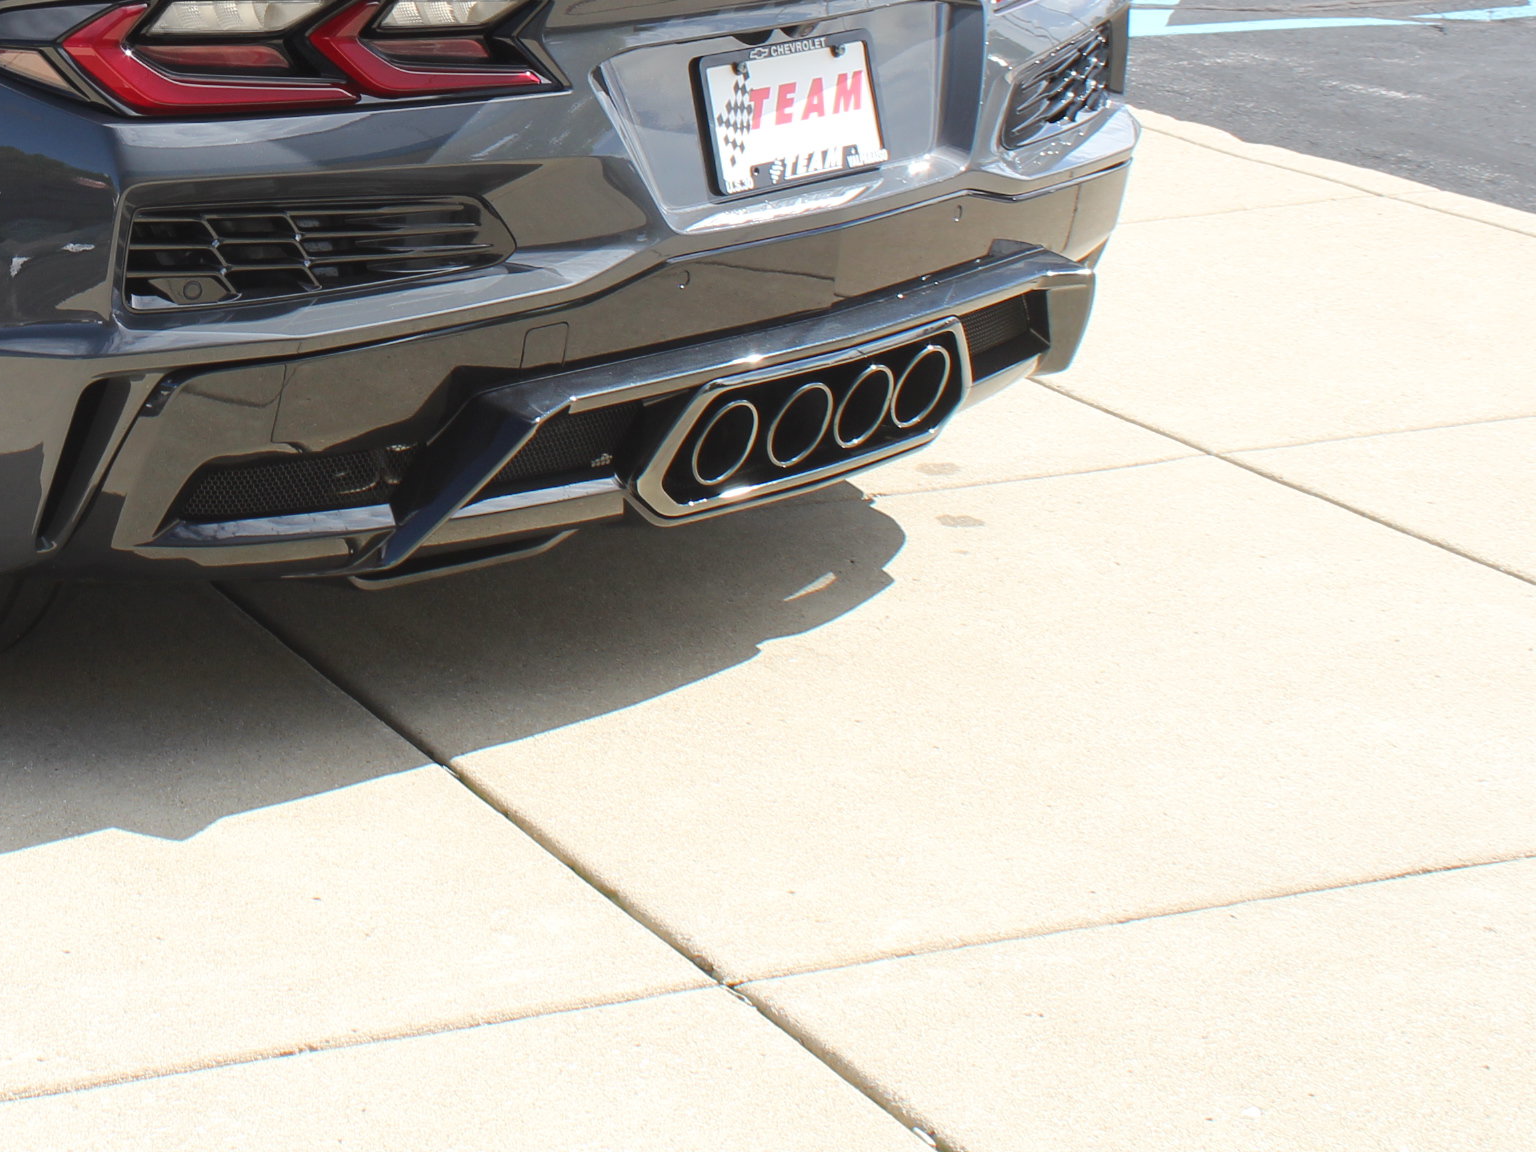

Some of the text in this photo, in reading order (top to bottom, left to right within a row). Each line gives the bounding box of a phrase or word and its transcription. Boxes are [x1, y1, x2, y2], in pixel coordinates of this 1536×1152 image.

[770, 37, 827, 57] CHEVROLET
[749, 69, 863, 130] TEAM
[784, 146, 844, 179] TEAM
